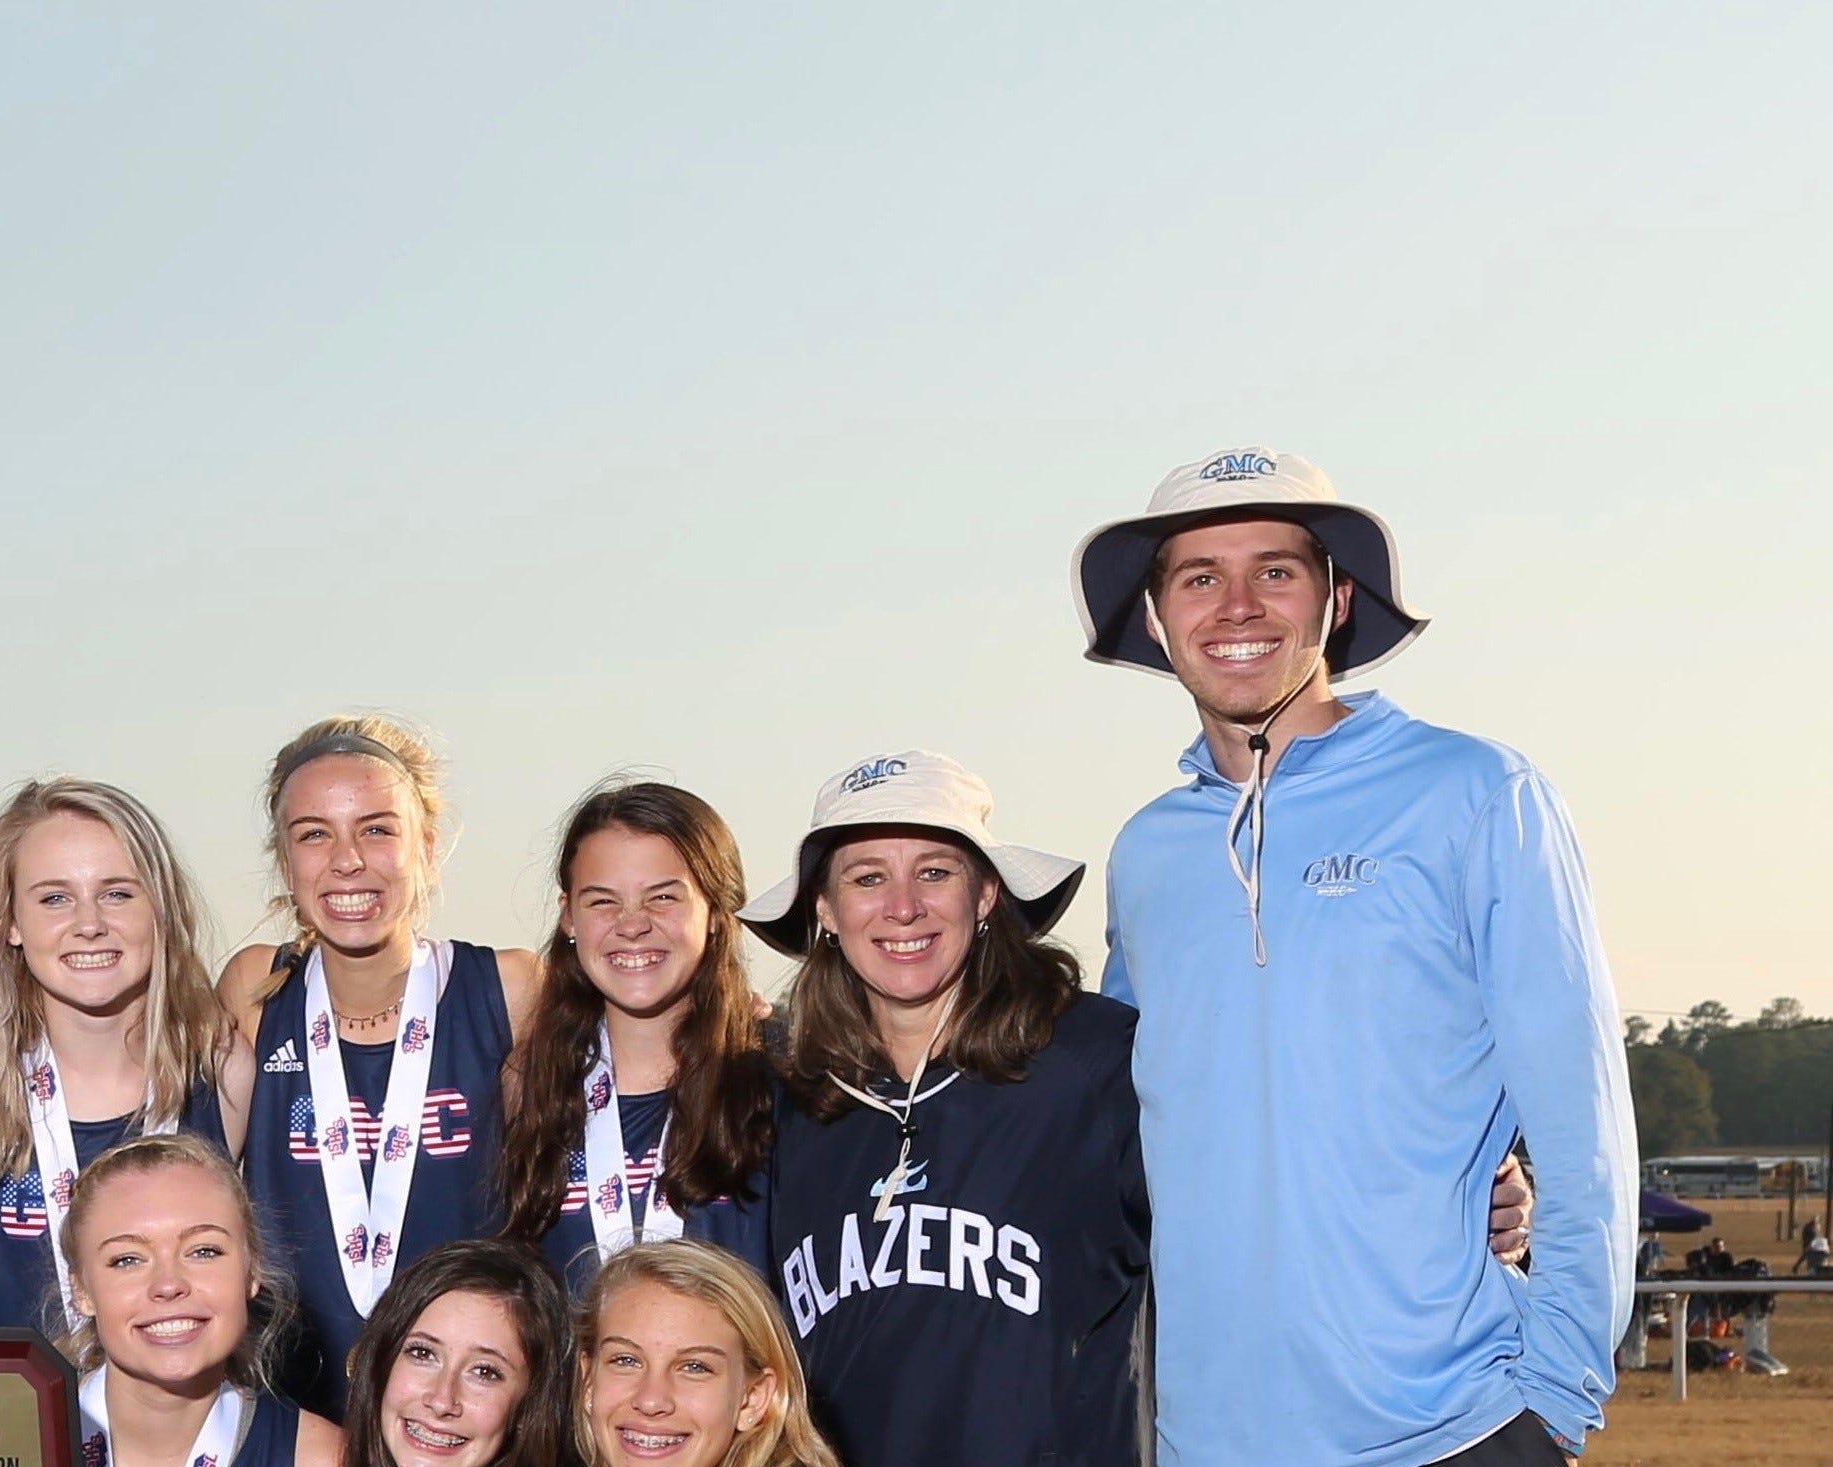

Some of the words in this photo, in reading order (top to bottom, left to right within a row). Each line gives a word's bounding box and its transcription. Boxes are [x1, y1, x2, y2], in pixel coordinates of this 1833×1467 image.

[1200, 454, 1277, 479] GMC
[839, 758, 907, 795] GMC
[1302, 853, 1381, 887] GMC
[782, 1203, 1042, 1339] BLAZERS
